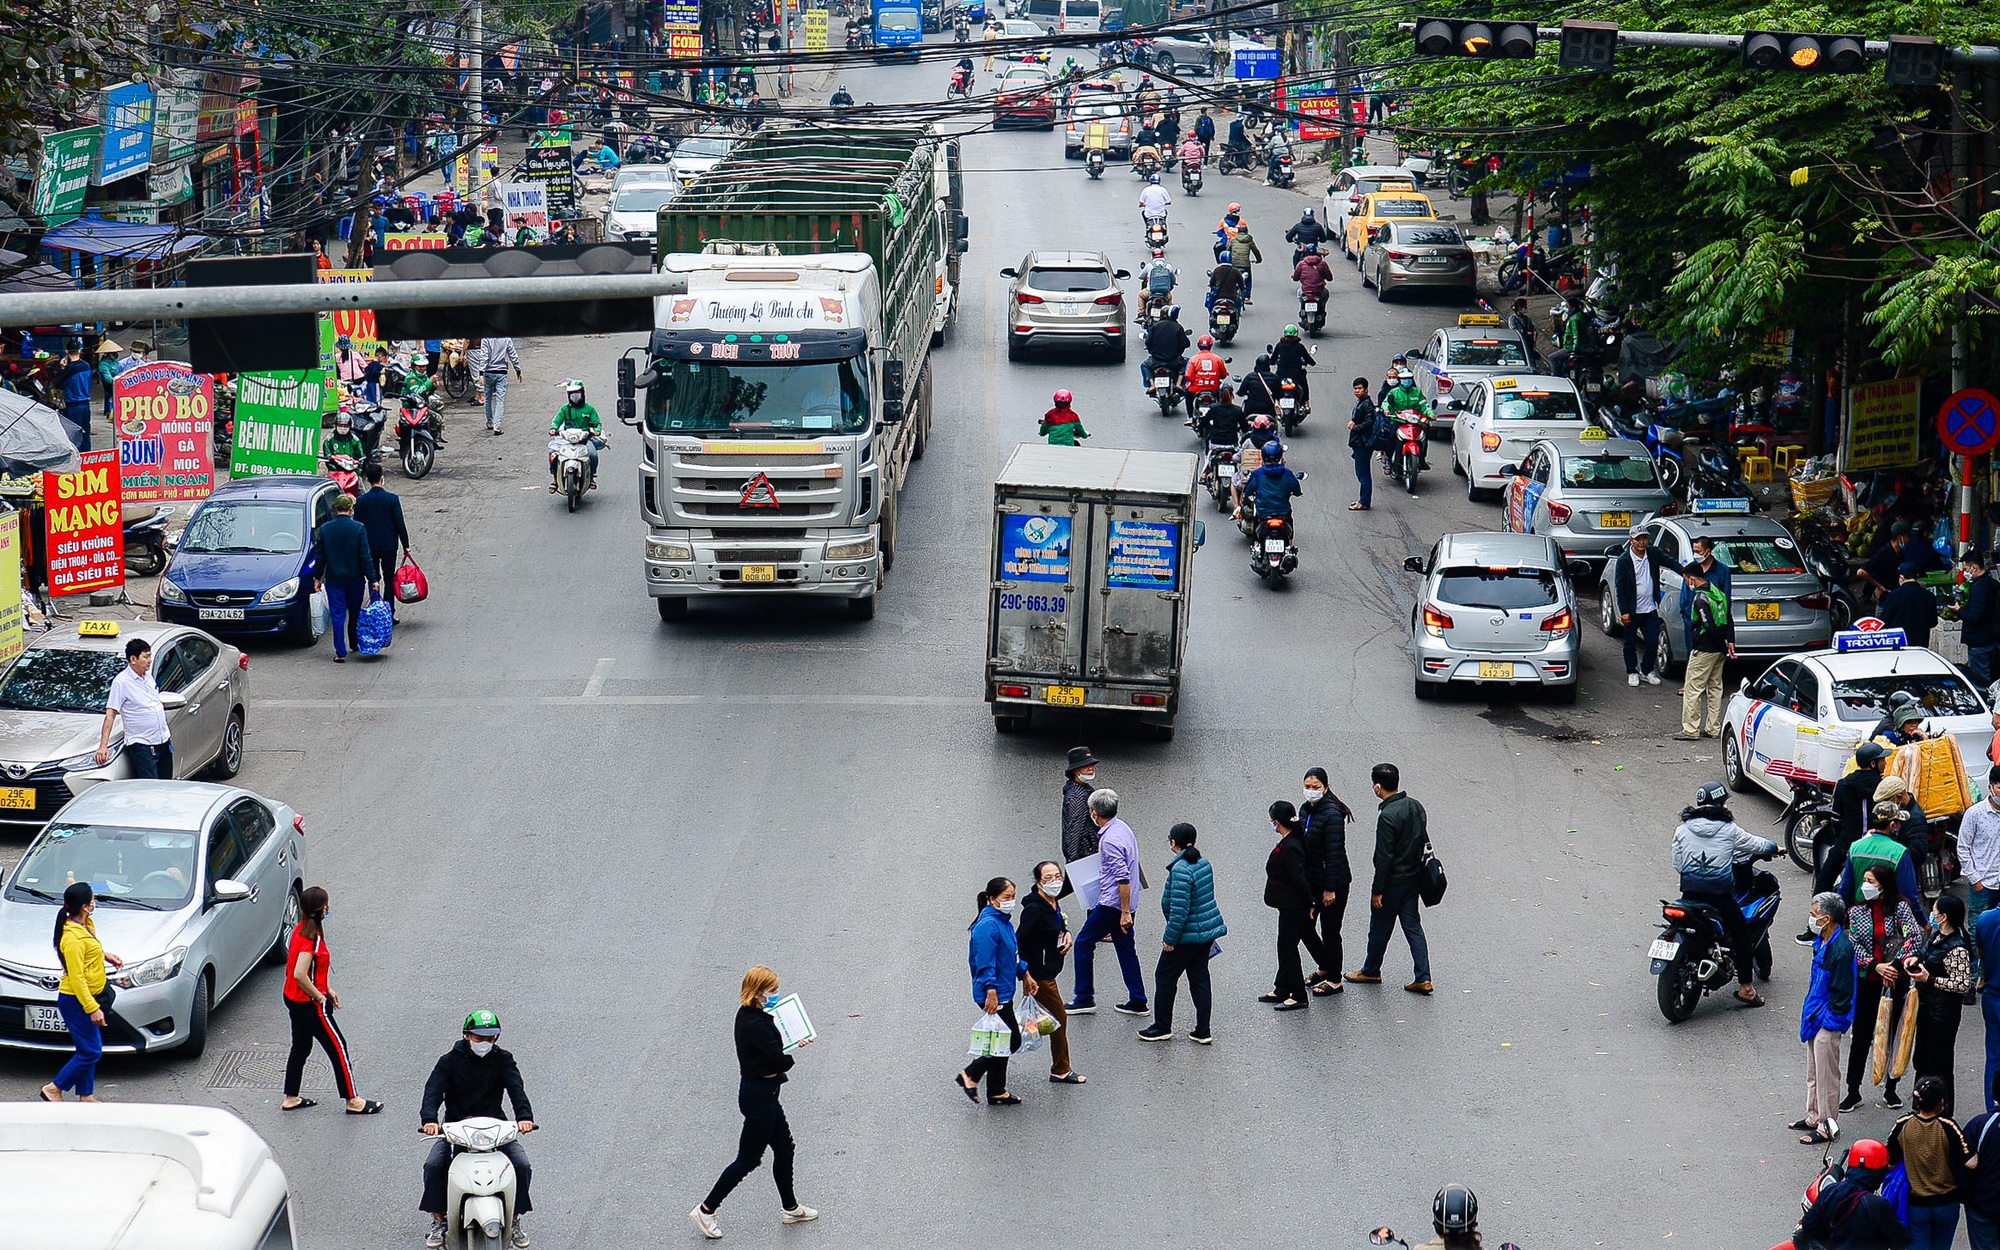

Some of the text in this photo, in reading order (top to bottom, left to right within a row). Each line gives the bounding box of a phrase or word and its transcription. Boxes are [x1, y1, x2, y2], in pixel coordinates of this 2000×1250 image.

[508, 189, 521, 207] NHÀ
[708, 301, 747, 323] Thượng
[769, 300, 794, 319] Bình
[241, 372, 279, 407] CHUYÊN
[300, 382, 320, 411] CHO
[119, 386, 209, 421] PHỞ BÒ
[161, 418, 212, 434] MÓNG GIÒ
[177, 437, 195, 452] GÀ
[238, 415, 315, 456] BỆNH NHÂN K
[120, 435, 157, 466] BÚN
[173, 458, 200, 472] MỌC
[57, 468, 109, 499] SIM
[122, 470, 209, 488] MIẾN NGAN
[1716, 500, 1731, 509] SÔNG
[49, 500, 119, 537] MẠNG
[57, 535, 114, 555] SIÊU KHỦNG
[54, 562, 119, 585] GIÁ SIÊU RẺ
[1001, 593, 1066, 613] 29C-663.39
[84, 622, 111, 630] TAXI
[1051, 695, 1080, 704] 663.39
[0, 798, 31, 807] 025.74
[7, 789, 25, 798] 29E
[38, 1008, 59, 1020] 30A
